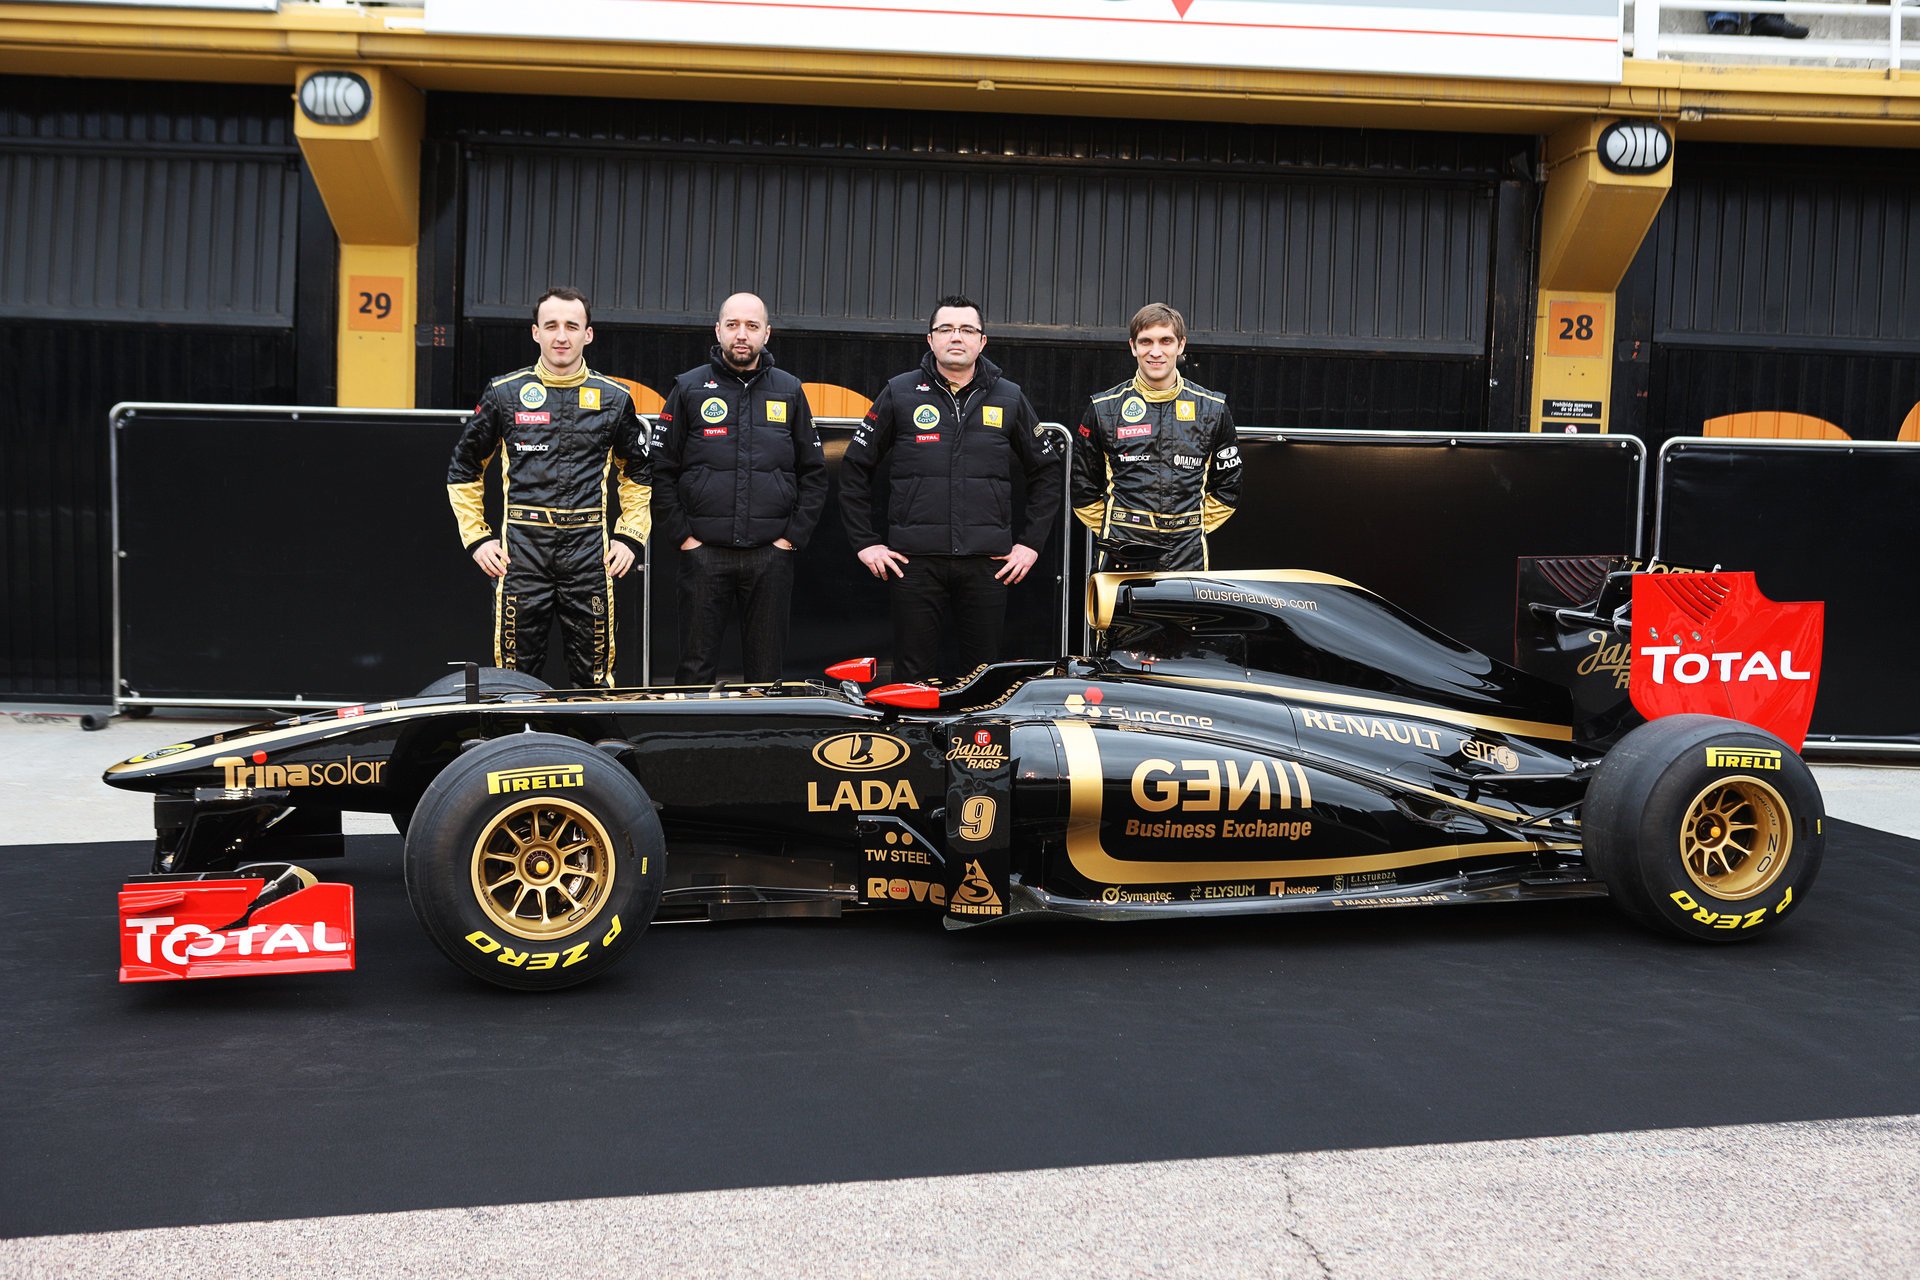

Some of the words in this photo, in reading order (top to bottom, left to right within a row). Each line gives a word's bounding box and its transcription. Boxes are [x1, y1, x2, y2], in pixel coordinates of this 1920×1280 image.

[359, 292, 392, 319] 29
[1559, 314, 1593, 340] 28
[524, 394, 543, 402] LOTUS
[517, 413, 548, 422] TOTAL
[705, 409, 724, 417] LOTUS
[1125, 408, 1144, 416] LOTUS
[1120, 427, 1151, 437] TOTAL
[1216, 456, 1242, 471] LADA
[1195, 585, 1318, 611] lotusrenaultgp.com
[505, 594, 518, 650] LOTUS
[593, 619, 605, 685] RENAULT
[1577, 630, 1632, 676] Jap
[1640, 645, 1811, 685] TOTAL
[1108, 706, 1214, 730] SunCore
[1299, 707, 1442, 751] RENAULT
[945, 736, 1008, 762] Japan
[1705, 746, 1782, 771] PIRELLI
[213, 750, 387, 789] Trinasolar
[967, 759, 1001, 769] RAGS
[486, 763, 584, 795] PIRELLI
[807, 779, 920, 813] LADA
[958, 795, 997, 842] 9
[1125, 819, 1216, 839] Business
[1222, 819, 1312, 841] Exchange
[864, 849, 888, 862] TW
[890, 849, 931, 865] STEEL
[1204, 885, 1255, 898] ELYSIUM
[1286, 886, 1319, 895] NetApp
[1775, 886, 1793, 914] P
[950, 903, 1003, 915] SIBUR
[1669, 889, 1767, 929] ZERO
[125, 915, 347, 966] TOTAL
[602, 914, 623, 947] P
[464, 930, 590, 971] ZERO
